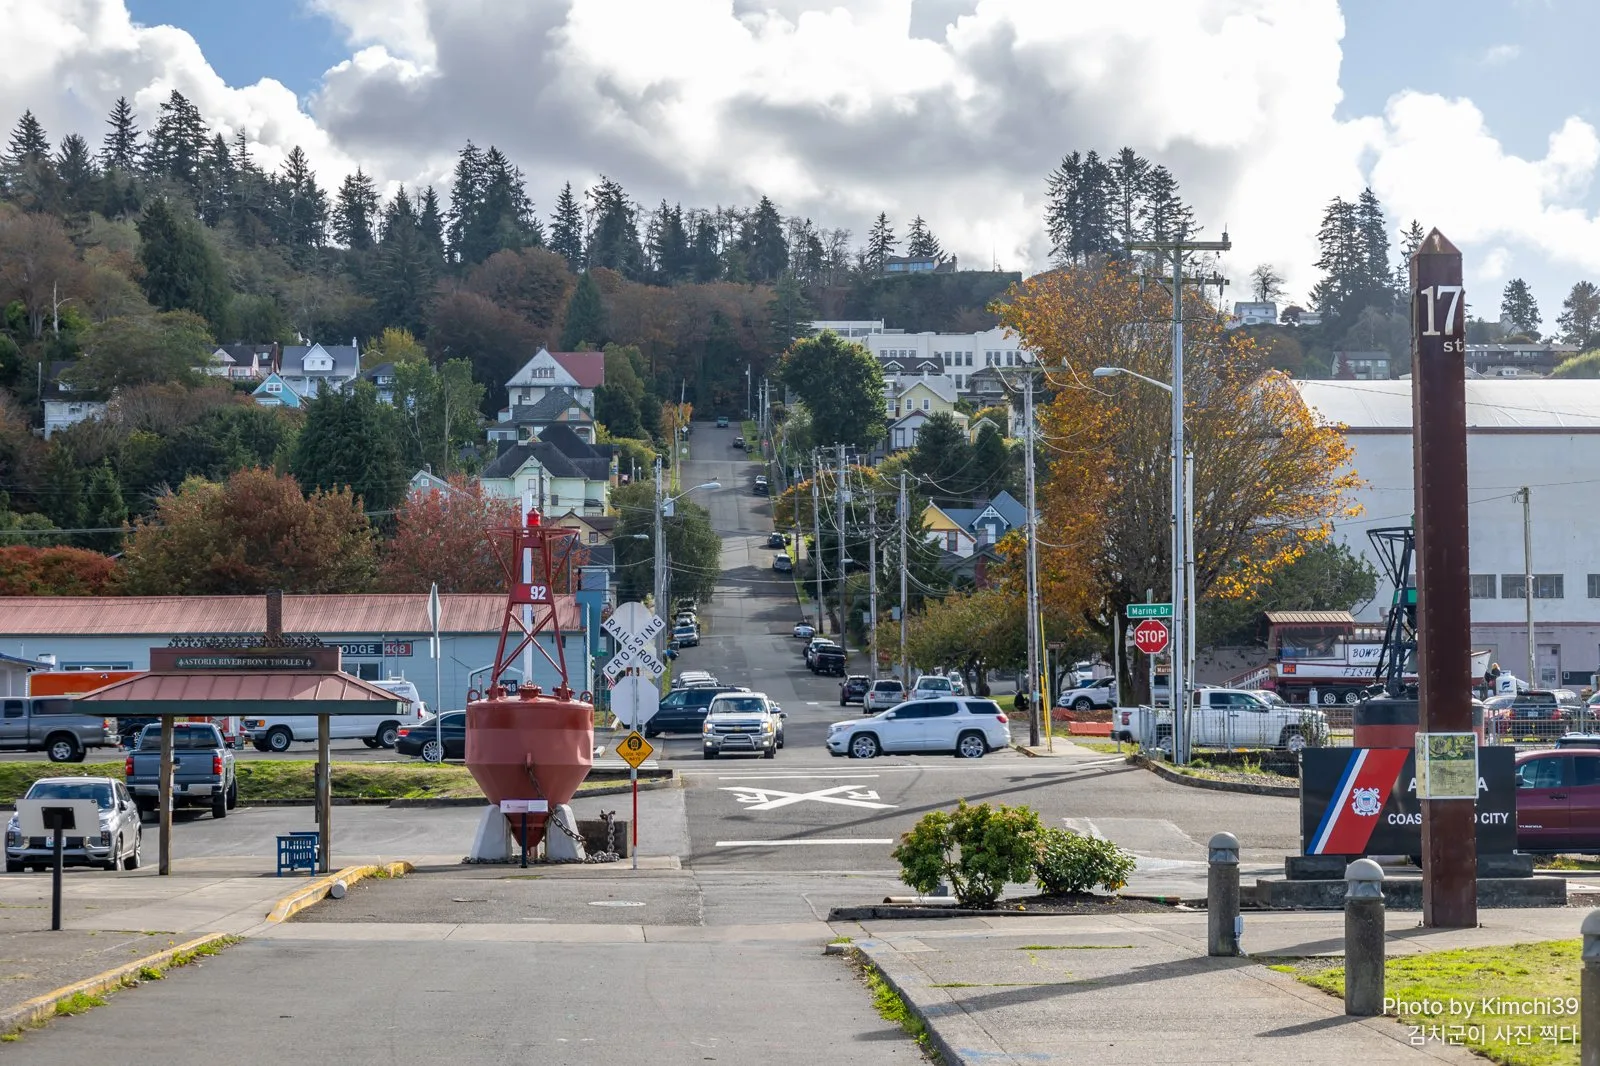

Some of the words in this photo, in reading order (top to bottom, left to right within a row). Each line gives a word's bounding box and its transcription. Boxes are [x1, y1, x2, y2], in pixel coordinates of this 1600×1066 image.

[1420, 285, 1463, 336] 17
[1443, 338, 1464, 353] st
[530, 585, 547, 600] 92
[1131, 607, 1157, 615] Marine
[1160, 606, 1169, 615] Dr
[1136, 630, 1166, 643] STOP
[341, 645, 375, 654] ODGE
[606, 617, 663, 676] CROSSING
[183, 658, 218, 666] ASTORIA
[218, 658, 270, 666] RIVERFRONT
[270, 658, 306, 667] TROLLEY
[1343, 667, 1373, 677] FISH
[1387, 813, 1422, 825] COAS
[1480, 812, 1509, 824] CITY
